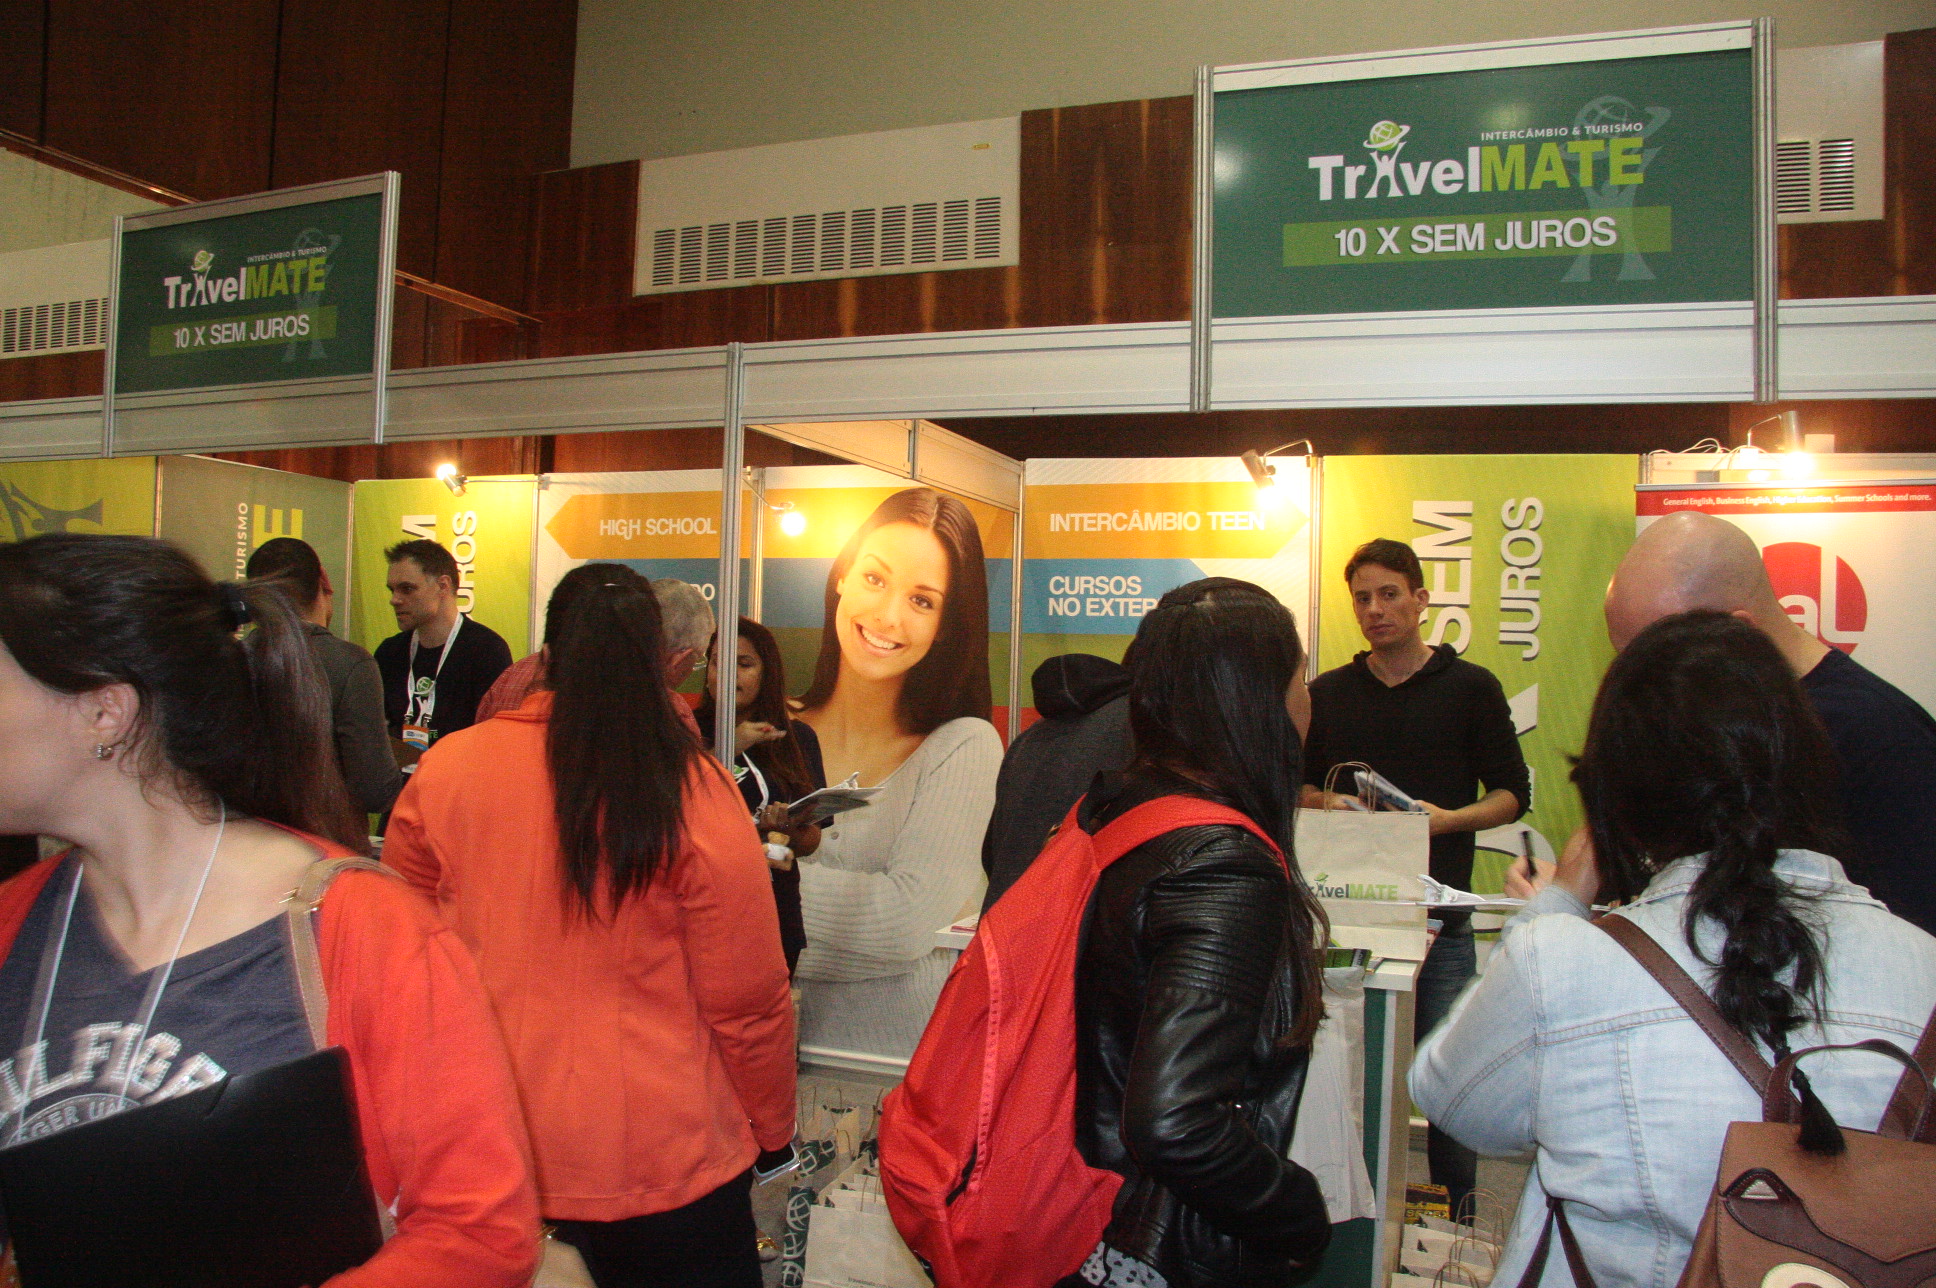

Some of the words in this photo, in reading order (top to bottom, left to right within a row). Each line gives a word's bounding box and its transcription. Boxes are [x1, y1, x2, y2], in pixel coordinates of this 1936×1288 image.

[1481, 127, 1569, 141] INTERCÂMBIO
[1572, 126, 1581, 136] &
[1584, 122, 1644, 135] TURISMO
[1334, 228, 1367, 257] 10
[1376, 226, 1401, 255] X
[1410, 222, 1485, 254] SEM
[1494, 216, 1618, 251] JUROS
[298, 246, 328, 257] TURISMO
[173, 327, 190, 349] 10
[194, 326, 206, 347] X
[210, 321, 246, 345] SEM
[249, 314, 310, 341] JUROS
[1663, 497, 1689, 506] General
[1690, 497, 1715, 507] English,
[1716, 496, 1745, 505] Business
[1834, 494, 1865, 503] Summer
[1866, 493, 1893, 502] Schools
[1894, 493, 1909, 501] and
[1909, 493, 1932, 501] more.
[600, 518, 642, 541] HIGH
[645, 517, 718, 536] SCHOOL
[1050, 509, 1201, 532] INTERCÂMBIO
[1207, 511, 1266, 531] TEEN
[234, 502, 249, 580] TURISMO
[452, 510, 477, 621] UROS
[1049, 575, 1143, 596] CURSOS
[1410, 500, 1473, 657] SEM
[1499, 497, 1544, 662] JUROS
[1048, 597, 1081, 616] NO
[1085, 597, 1160, 617] EXTER
